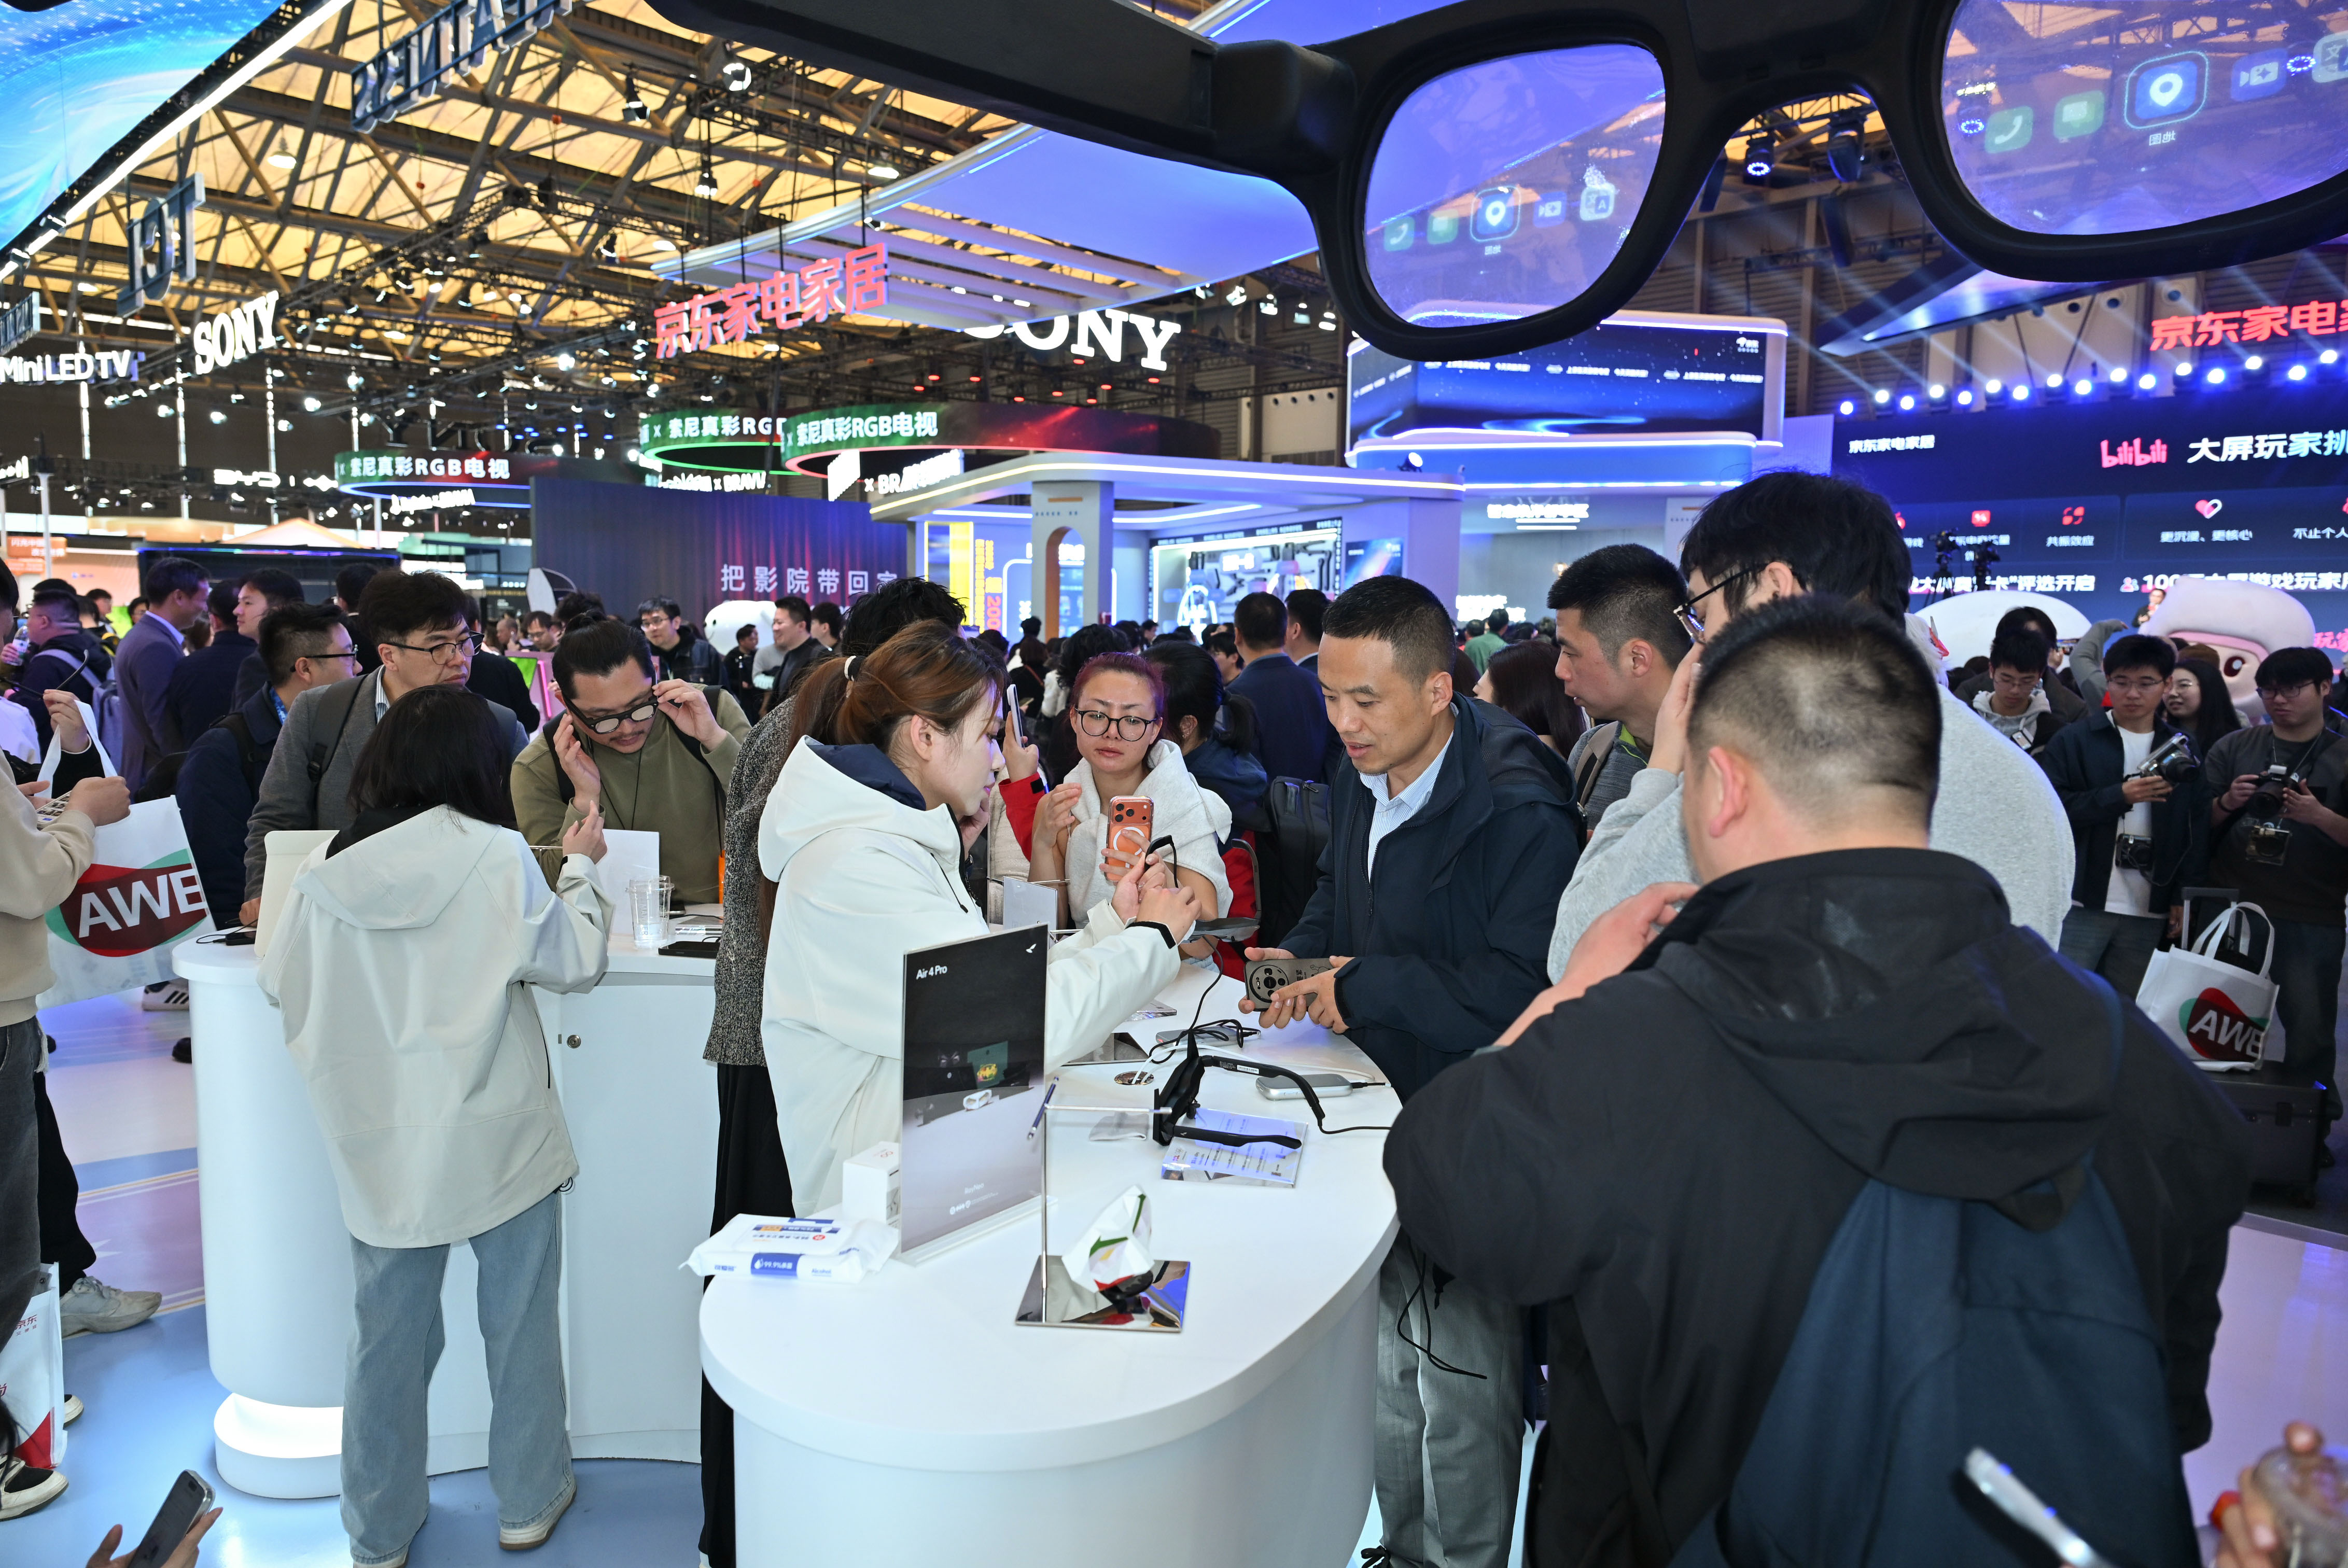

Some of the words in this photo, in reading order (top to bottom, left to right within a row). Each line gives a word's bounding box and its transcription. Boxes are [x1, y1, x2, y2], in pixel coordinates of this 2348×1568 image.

[654, 243, 887, 359] 京东家电家居
[194, 291, 279, 375] SONY
[965, 309, 1181, 371] ONY
[95, 349, 130, 379] TV
[797, 411, 939, 447] 索尼真彩RGB电视
[351, 456, 510, 479] 索尼真彩RGB电视
[2100, 437, 2168, 468] bilibili
[78, 868, 206, 939] AWE
[916, 968, 928, 980] Air
[928, 967, 934, 976] 4
[934, 964, 947, 975] Pro
[2189, 1010, 2265, 1058] AWE
[16, 1314, 38, 1330] 京东
